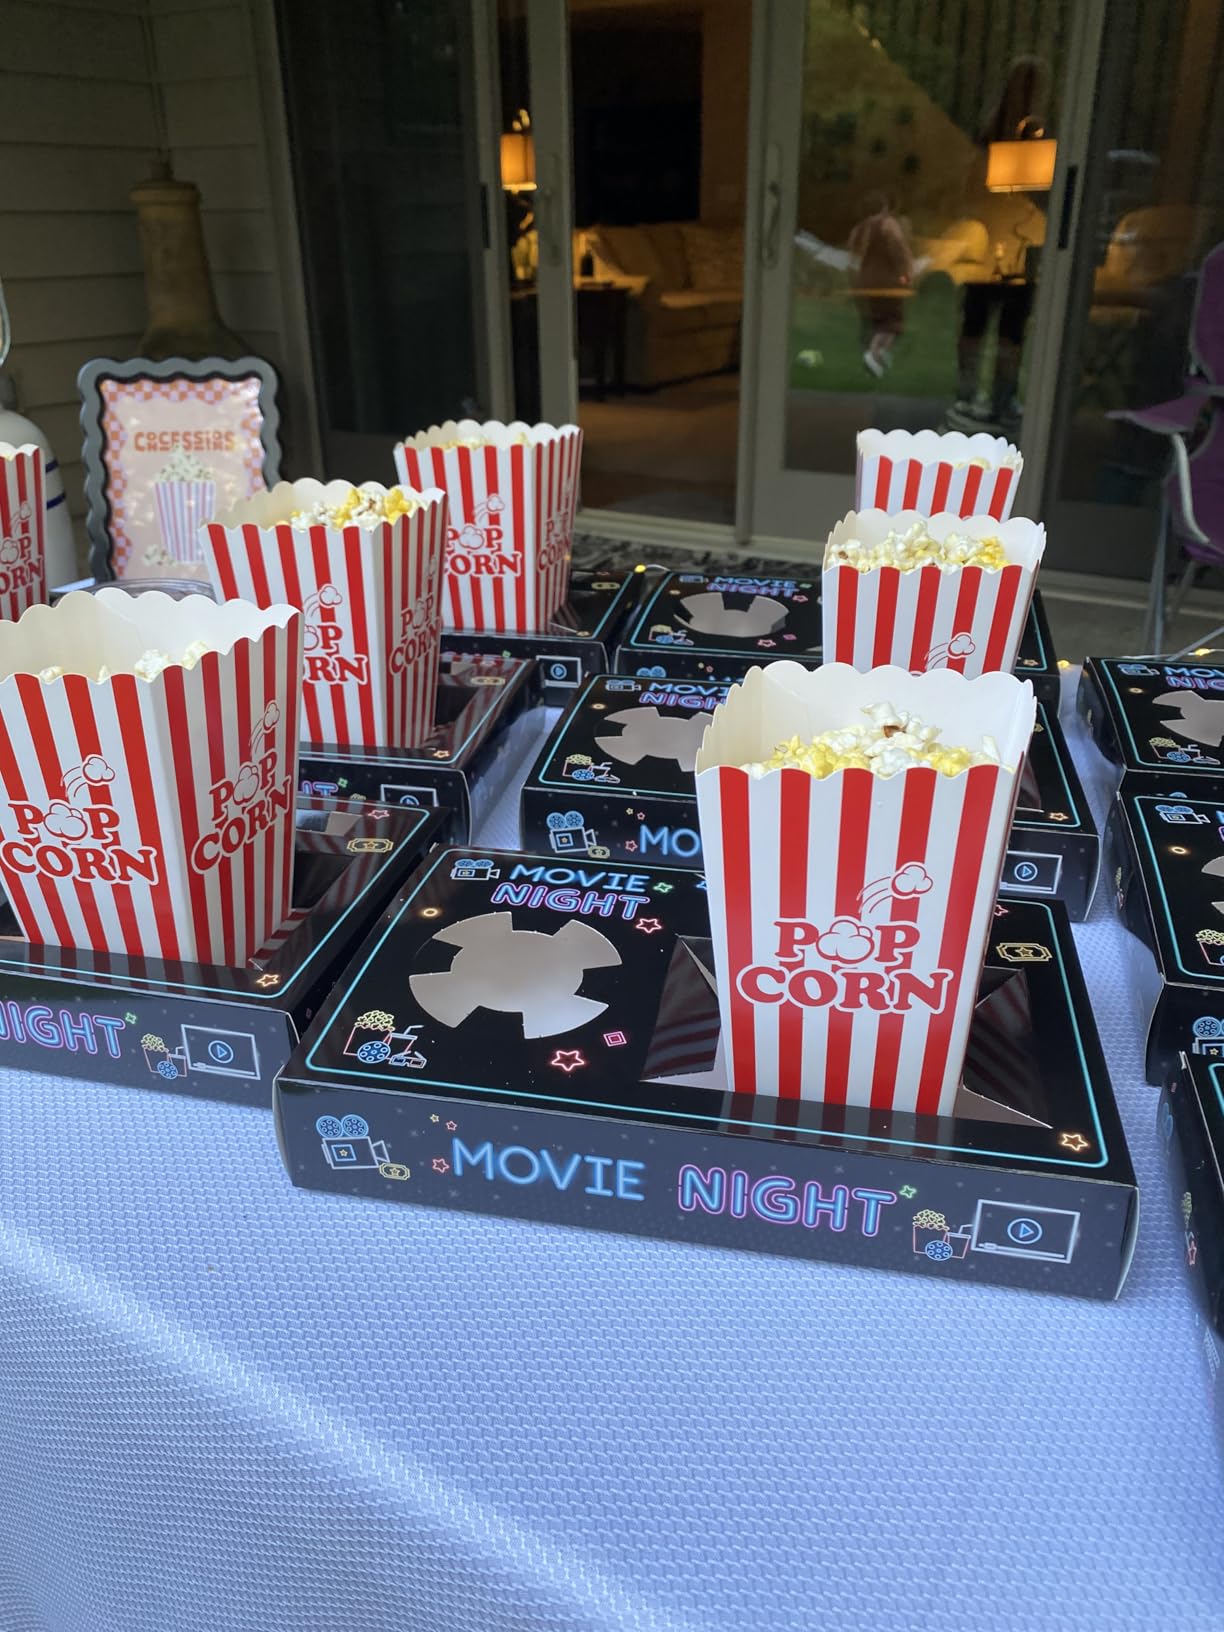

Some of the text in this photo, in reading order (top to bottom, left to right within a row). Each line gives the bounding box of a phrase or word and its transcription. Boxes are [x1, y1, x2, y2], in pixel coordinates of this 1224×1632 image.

[0, 555, 43, 595] ORN
[706, 582, 800, 598] NIGHT
[714, 576, 798, 588] MOVIE
[303, 655, 367, 682] RN
[639, 692, 728, 709] NIGH
[648, 682, 731, 697] MOVI
[209, 751, 278, 821] POP
[7, 802, 120, 842] POP
[192, 776, 291, 873] CORN
[2, 841, 157, 884] CORN
[508, 864, 651, 892] MOVIE
[490, 882, 650, 920] NIGHT
[774, 918, 921, 966] POP
[737, 965, 952, 1013] CORN
[0, 1000, 126, 1058] IGHT
[451, 1136, 898, 1238] MOVIE NIGHT
